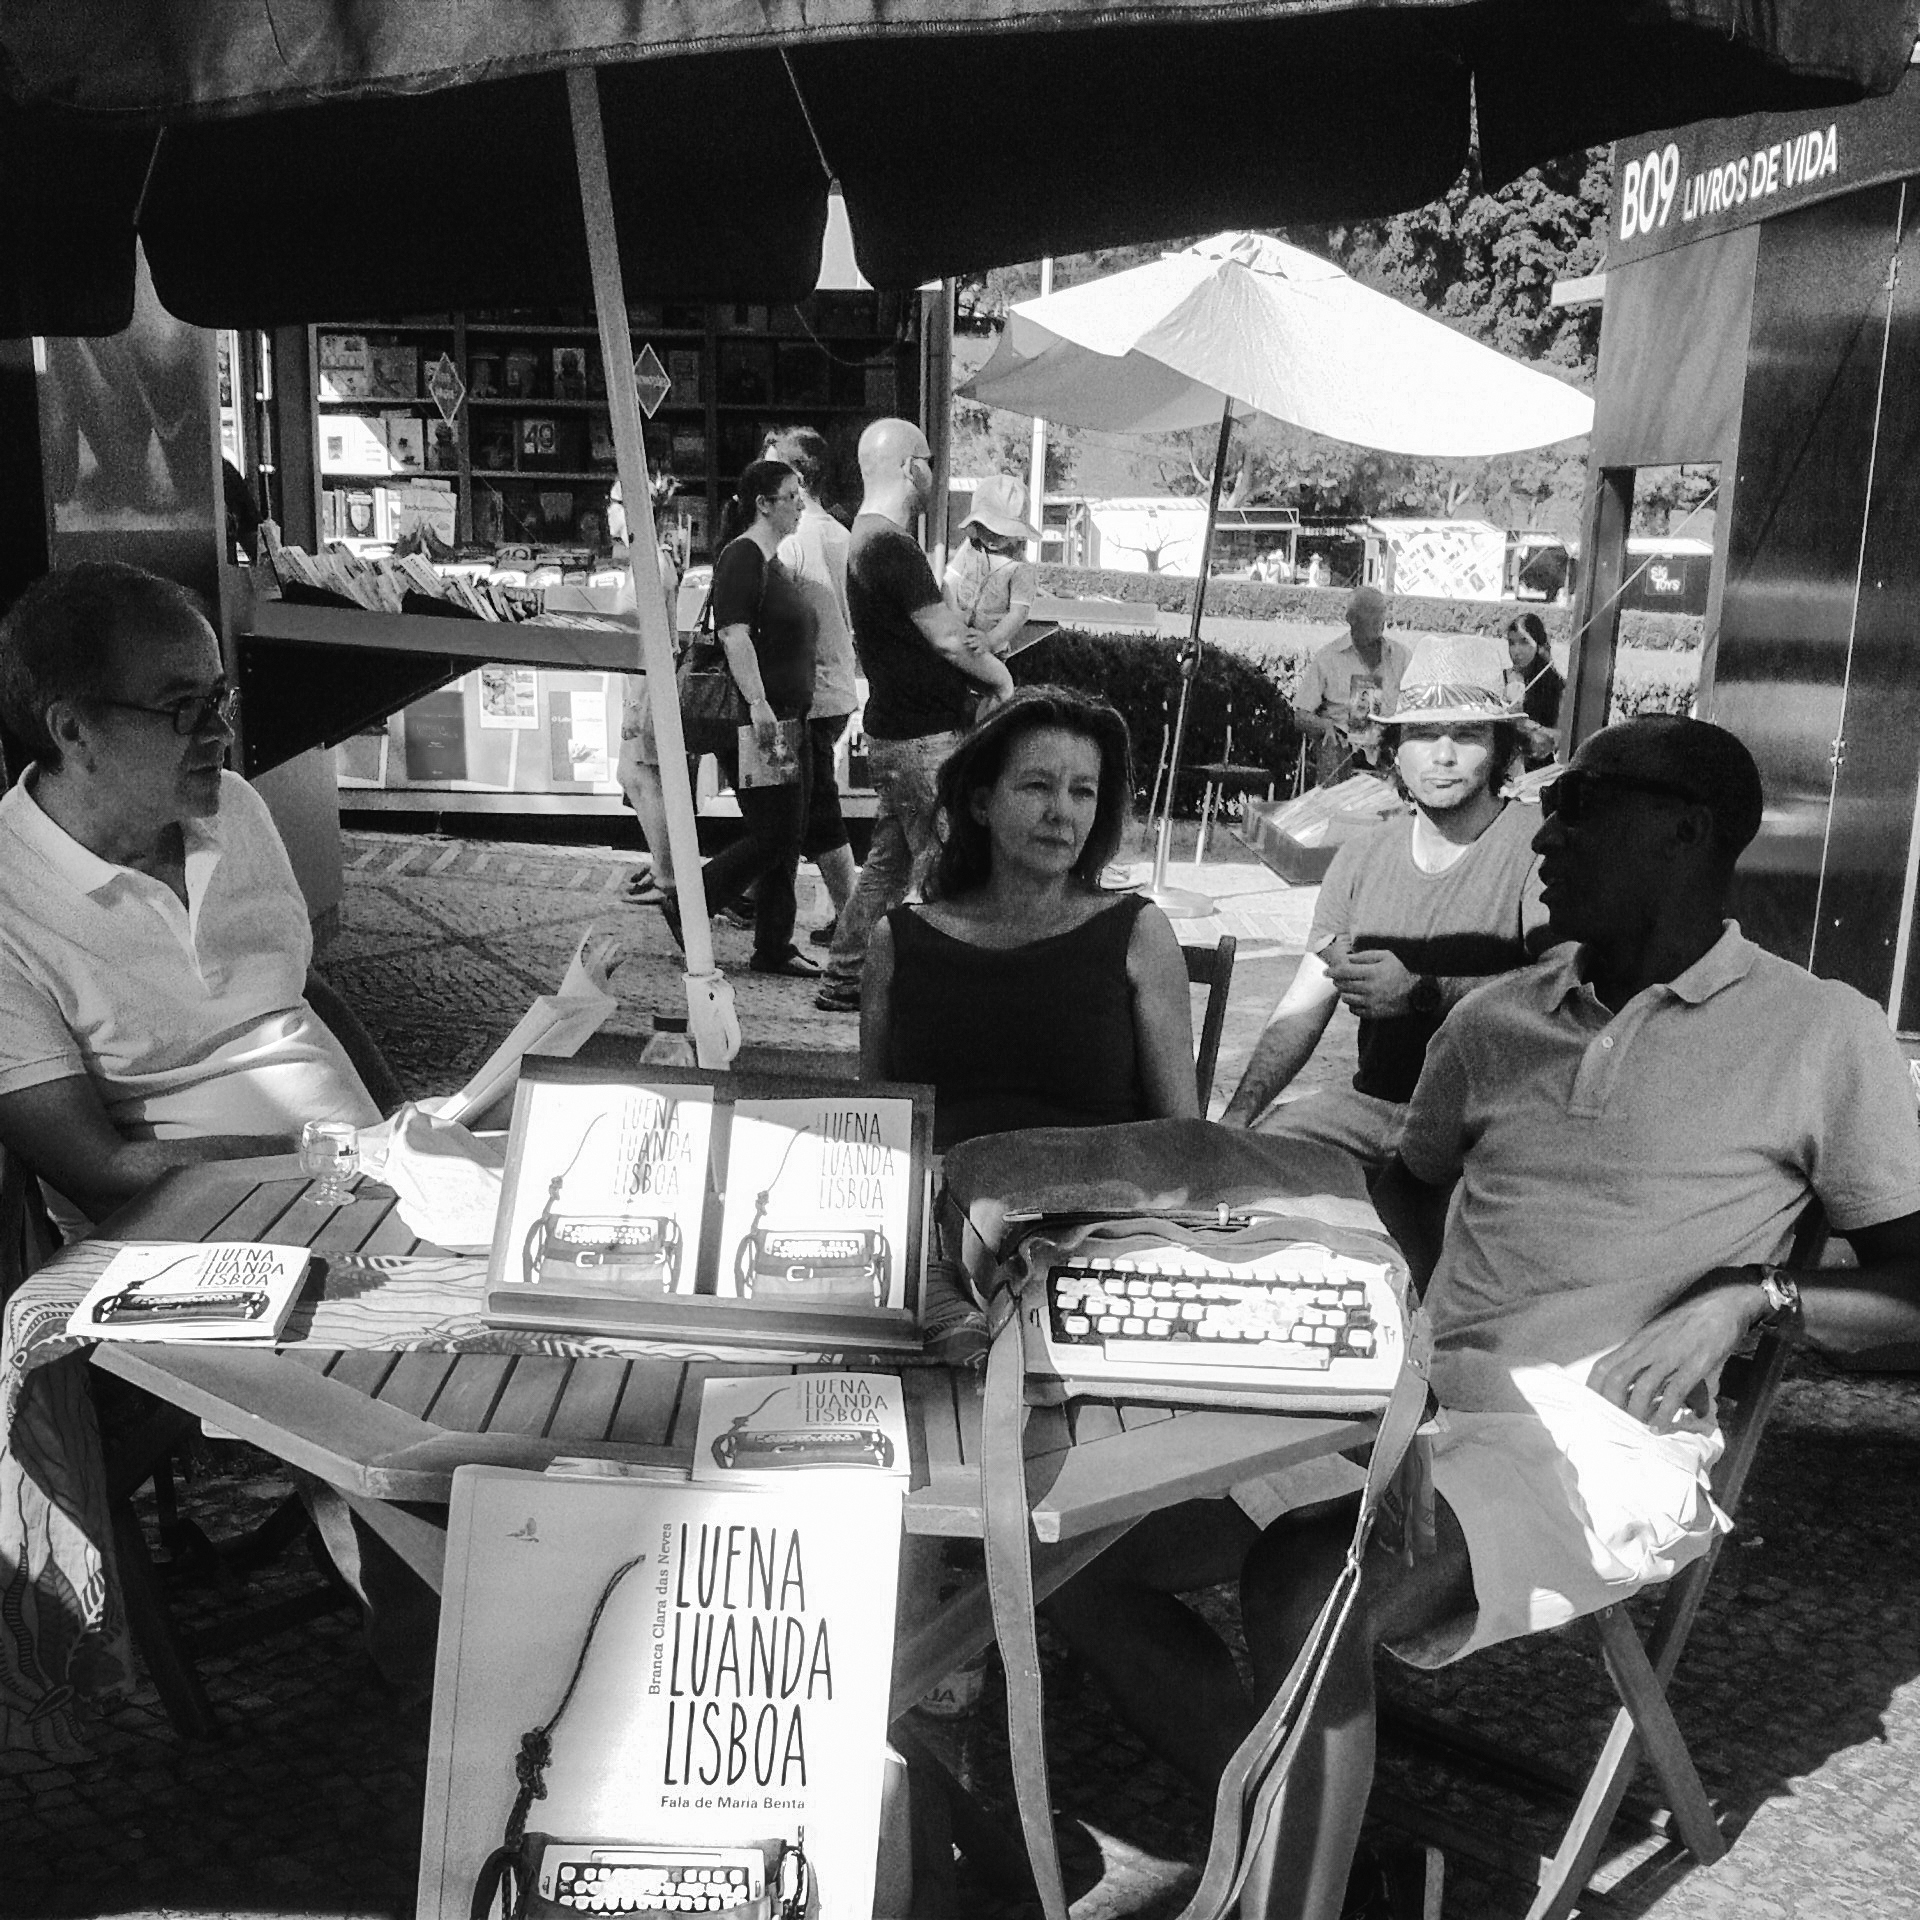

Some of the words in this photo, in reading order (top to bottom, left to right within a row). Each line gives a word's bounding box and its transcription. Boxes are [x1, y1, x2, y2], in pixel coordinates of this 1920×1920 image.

[1683, 156, 1749, 221] LIVROS
[1750, 144, 1782, 200] DE
[1785, 122, 1838, 189] VIDA
[823, 1112, 882, 1143] LUENA
[821, 1144, 895, 1177] LUANDA
[613, 1162, 680, 1196] LISBOA
[819, 1177, 884, 1210] LISBOA
[806, 1379, 870, 1395] LUENA
[806, 1393, 888, 1410] LUANDA
[806, 1408, 880, 1423] LISBOA
[657, 1523, 672, 1565] Neves
[655, 1569, 669, 1595] das
[676, 1523, 805, 1612] LUENA
[653, 1600, 666, 1639] Clara
[648, 1643, 663, 1695] Branca
[670, 1612, 832, 1700] LUANDA
[664, 1701, 806, 1787] LISBOA
[661, 1795, 690, 1808] Fala
[695, 1797, 713, 1809] de
[717, 1796, 758, 1809] Maria
[763, 1797, 805, 1809] Benta
